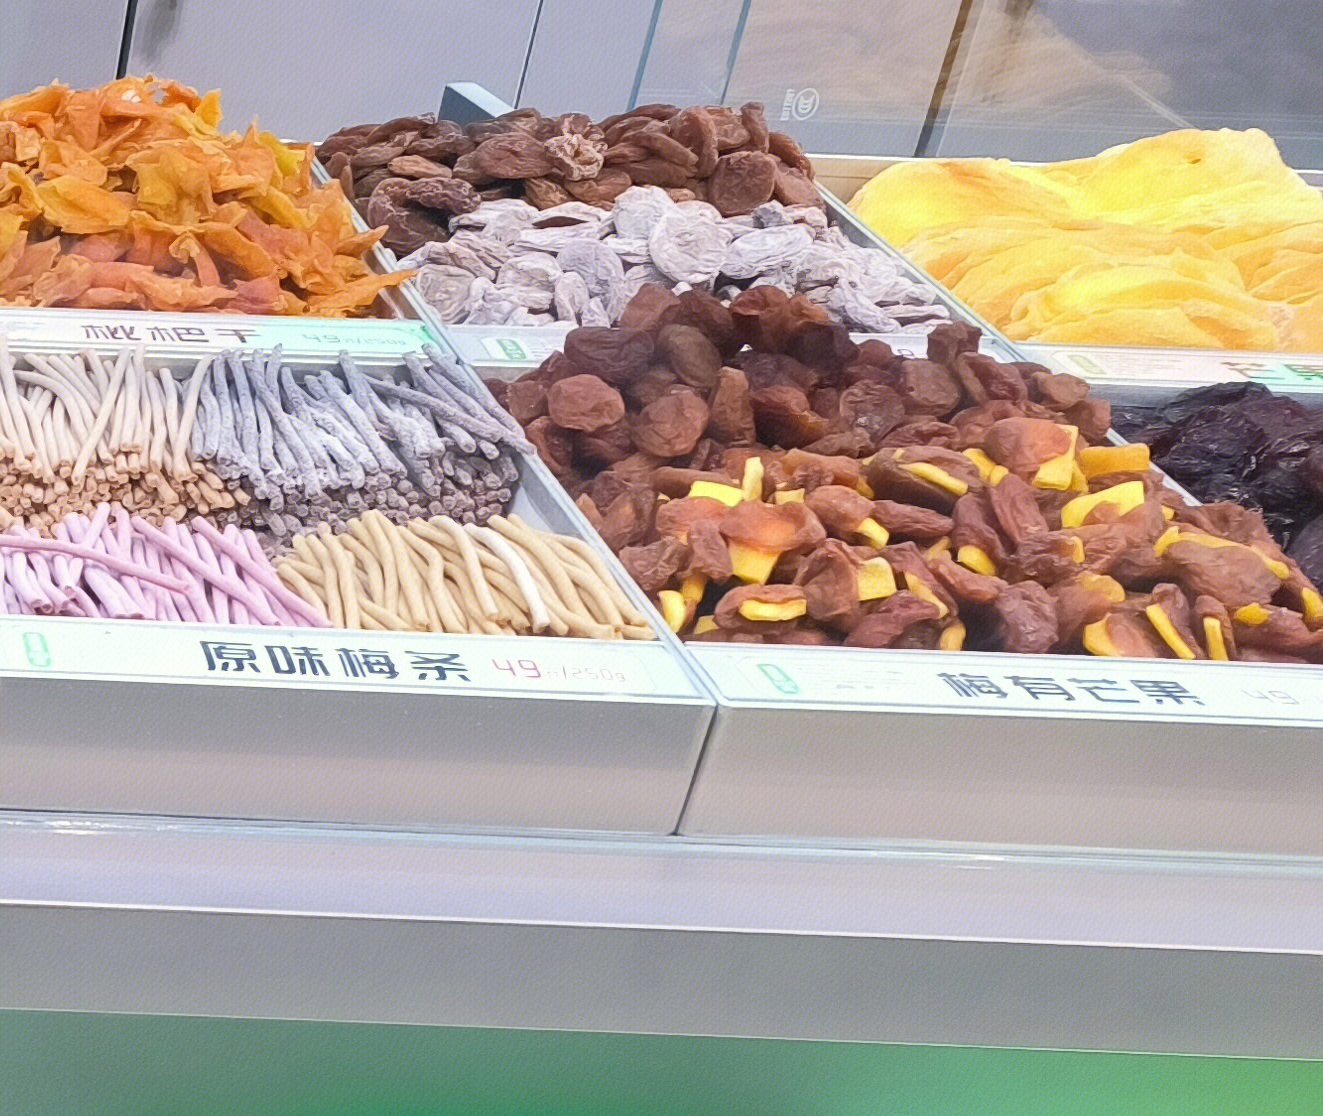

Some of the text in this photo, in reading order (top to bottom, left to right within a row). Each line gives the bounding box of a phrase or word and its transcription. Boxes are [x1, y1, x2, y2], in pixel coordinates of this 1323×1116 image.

[81, 324, 261, 344] 枇杷干
[200, 640, 472, 683] 原味梅条
[936, 672, 1206, 706] 梅有芒果
